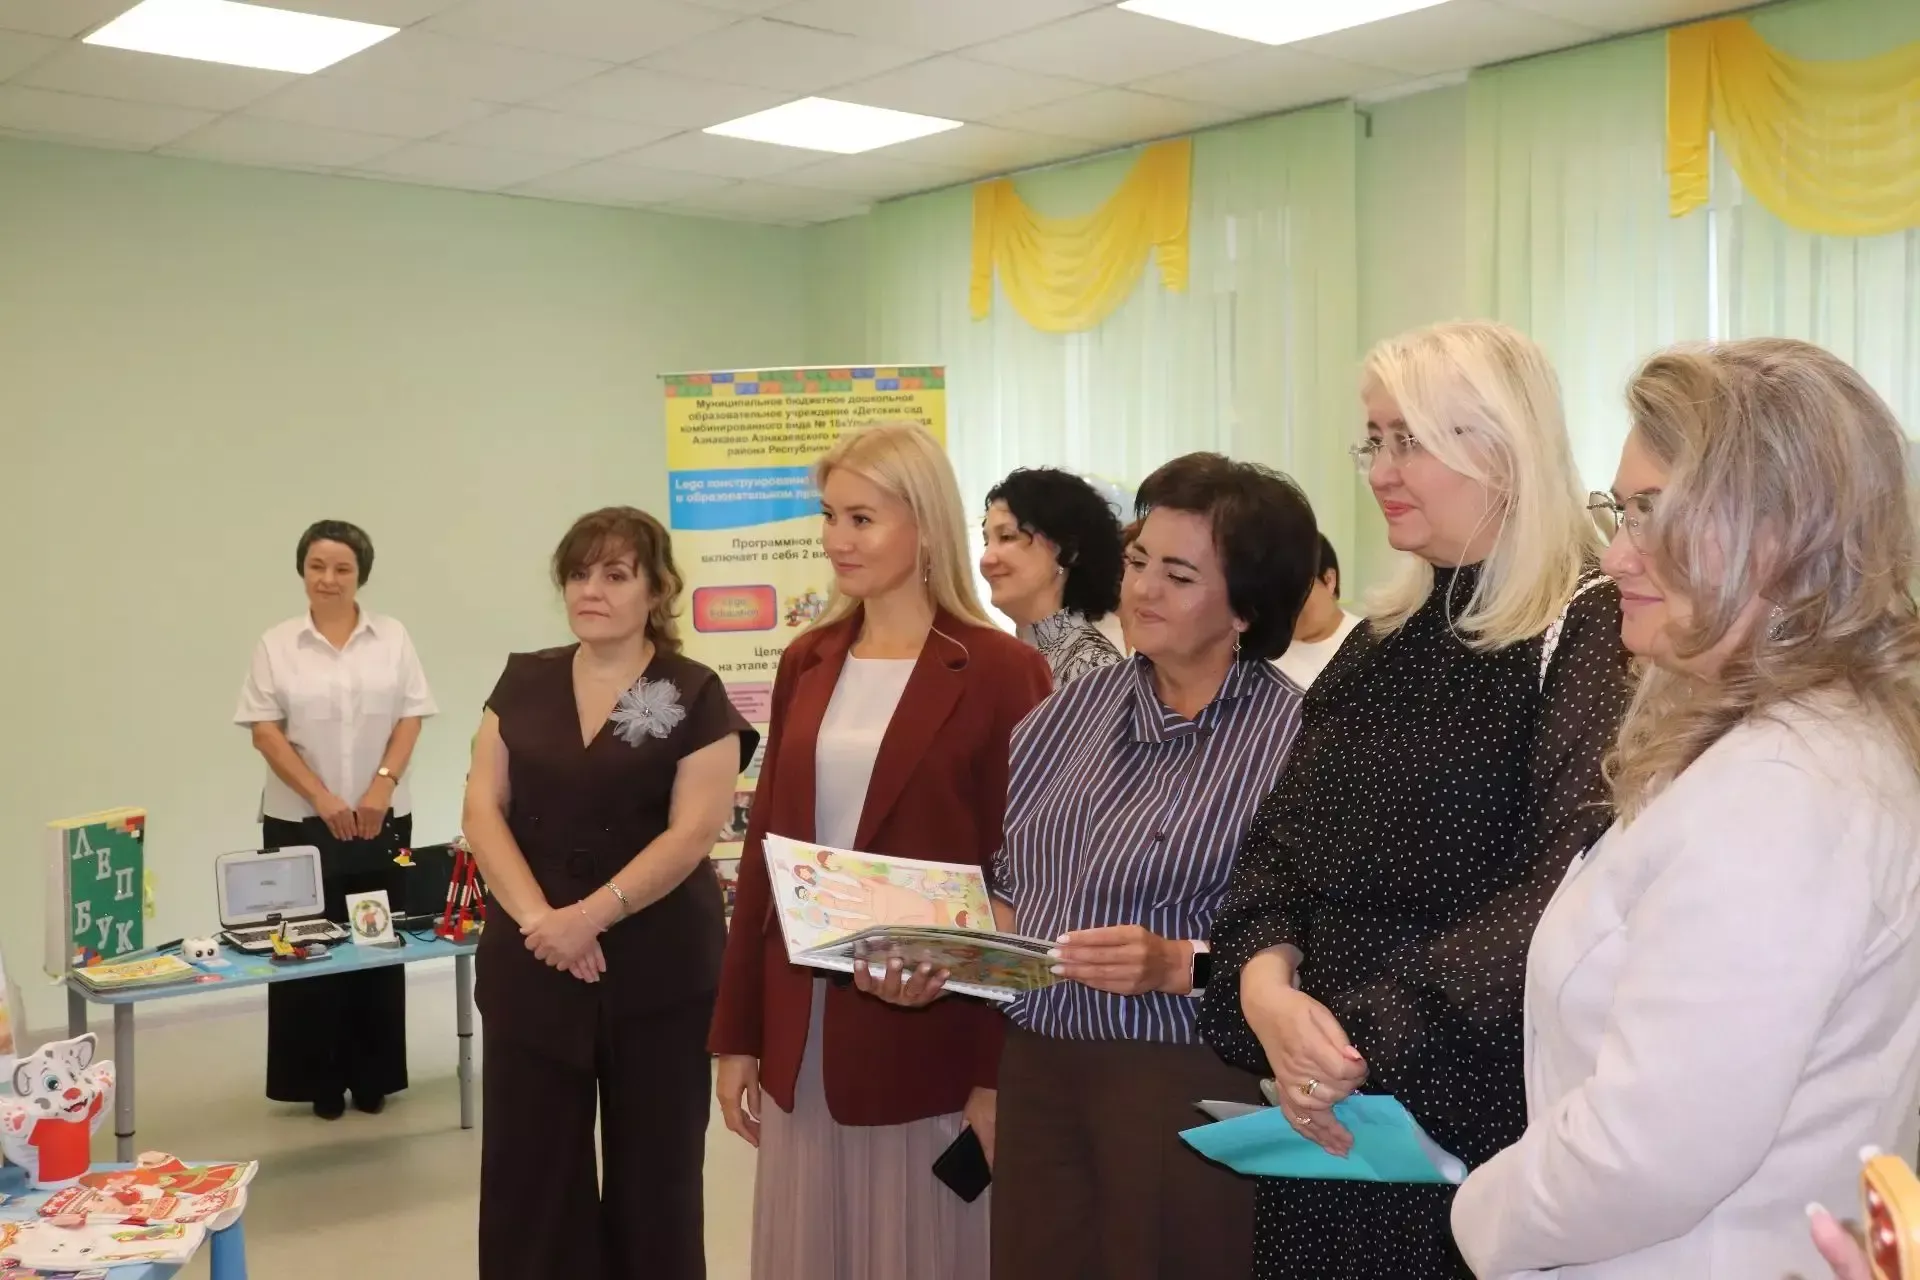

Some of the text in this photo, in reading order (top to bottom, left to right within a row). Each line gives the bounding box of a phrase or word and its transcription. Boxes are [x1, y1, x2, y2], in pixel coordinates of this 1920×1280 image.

[696, 398, 783, 410] Муниципальное
[848, 394, 915, 404] дошкольное
[688, 410, 783, 421] образовательное
[785, 408, 849, 419] учреждение
[904, 406, 923, 415] сад
[680, 422, 783, 433] комбинированного
[785, 420, 812, 430] вида
[727, 446, 766, 458] района
[675, 478, 704, 492] Lego
[732, 537, 812, 550] Программное
[701, 552, 758, 563] включает
[761, 552, 768, 561] в
[771, 549, 799, 560] себя
[802, 549, 809, 559] 2
[718, 663, 732, 671] на
[735, 661, 769, 671] этапе
